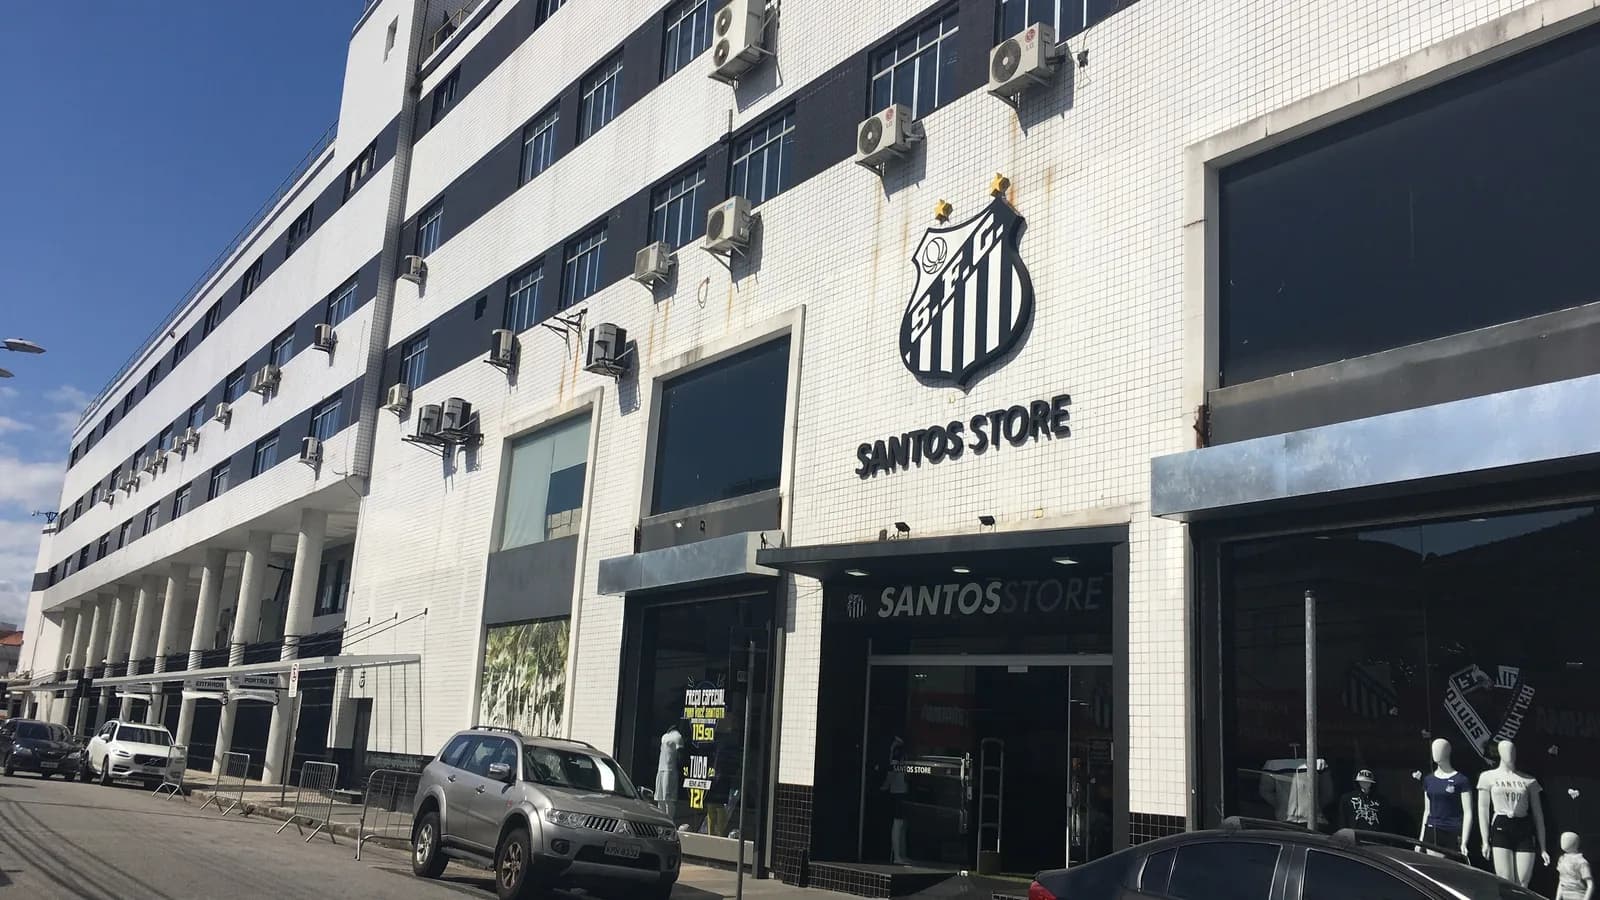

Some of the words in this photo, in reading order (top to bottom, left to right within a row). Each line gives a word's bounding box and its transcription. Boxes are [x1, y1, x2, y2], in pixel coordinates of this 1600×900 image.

[855, 420, 965, 480] SANTOS
[969, 393, 1073, 456] STORE
[878, 581, 1003, 618] SANTOS
[690, 755, 708, 779] TUDO
[914, 766, 931, 774] STORE
